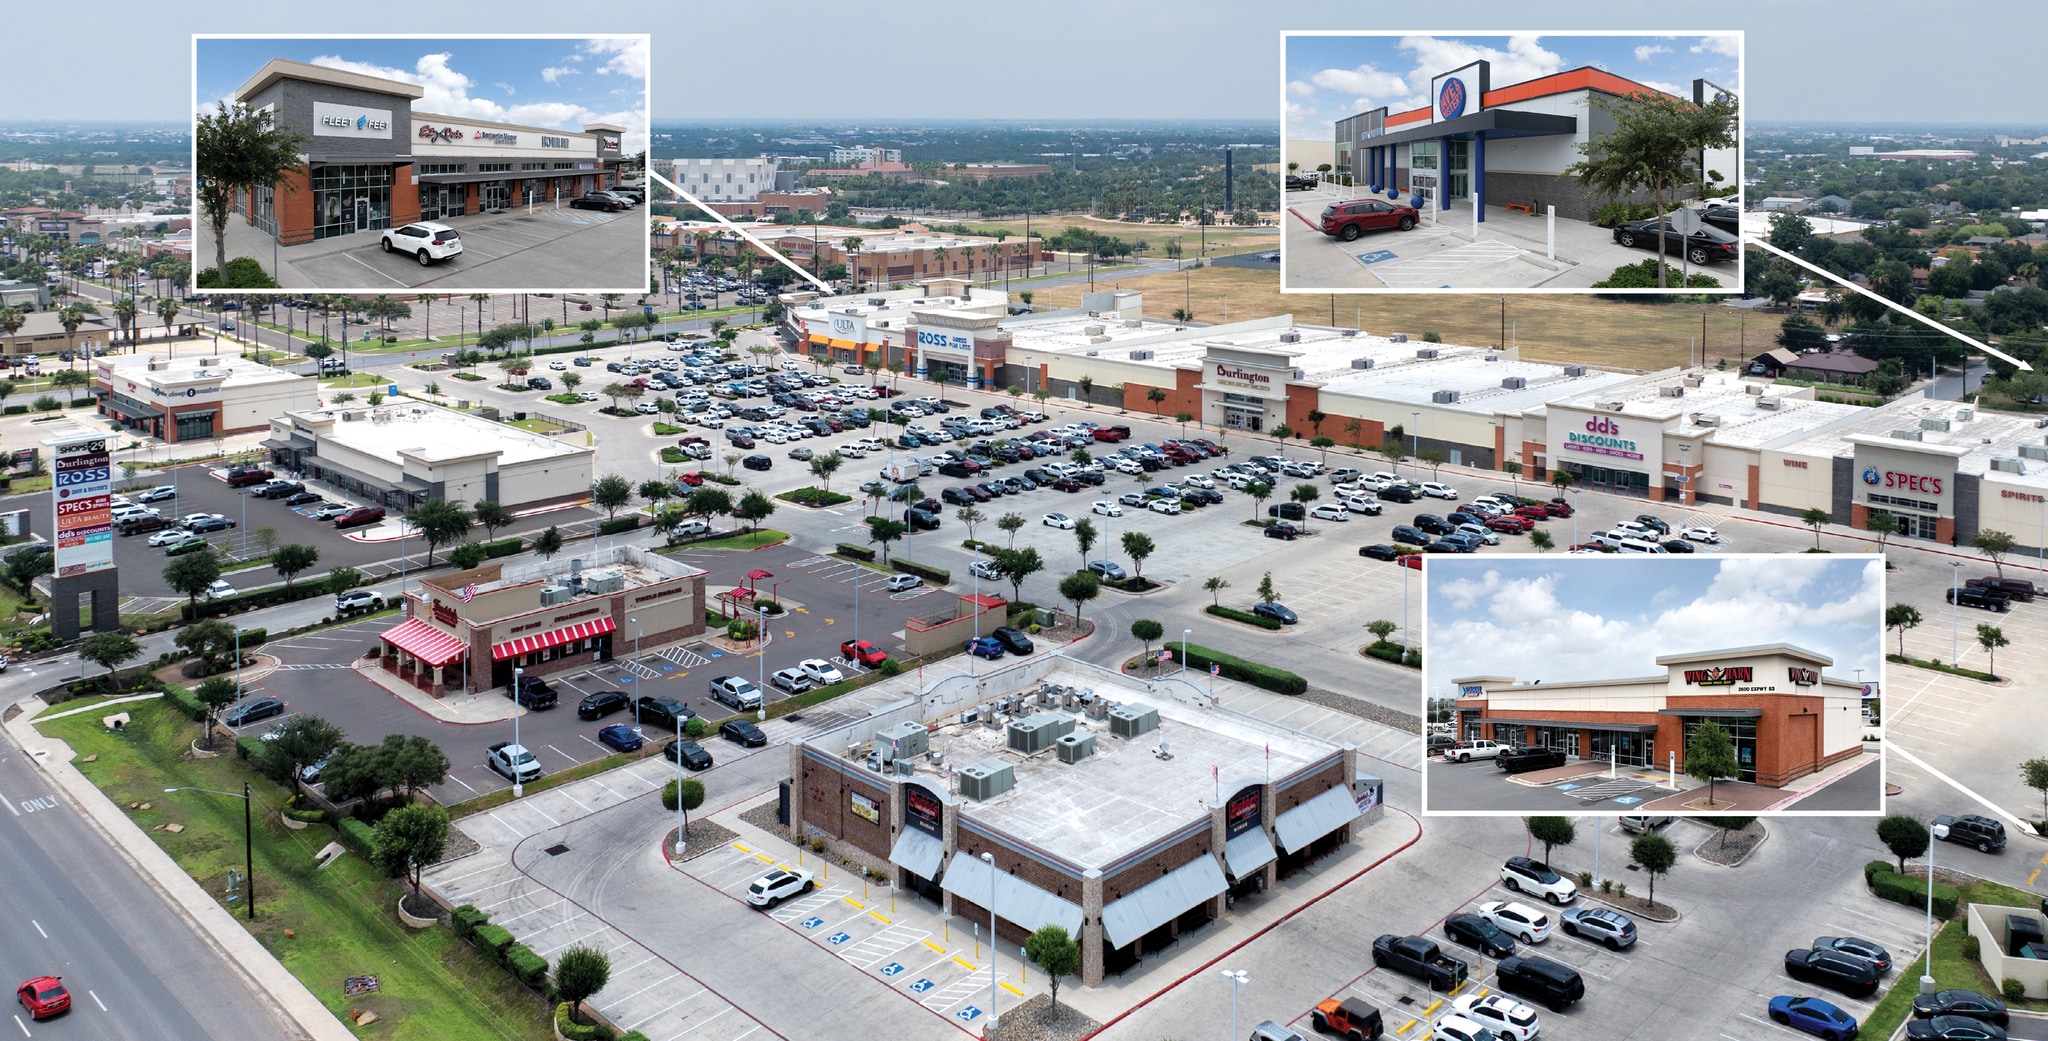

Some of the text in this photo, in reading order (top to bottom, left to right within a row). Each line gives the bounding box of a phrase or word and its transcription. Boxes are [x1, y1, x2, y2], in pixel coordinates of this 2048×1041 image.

[322, 115, 390, 130] FLEET FEET
[836, 319, 855, 331] ULTA
[919, 331, 947, 347] ROSS
[1217, 364, 1270, 384] Burlington
[1586, 416, 1619, 435] dd's
[1569, 432, 1636, 451] DISCOUNTS
[60, 444, 87, 454] SHOPS
[57, 456, 108, 468] Burlington
[1783, 458, 1808, 469] WINE
[59, 468, 107, 485] ROSS
[1885, 471, 1943, 495] SPEC'S
[2000, 489, 2044, 503] SPIRITS
[59, 500, 92, 514] SPEC'S
[61, 513, 109, 526] ULTA BEAUTY
[76, 526, 111, 536] DISCOUNTS
[511, 625, 524, 633] HOT
[1684, 667, 1753, 685] WING BARN
[21, 794, 59, 813] ONLY
